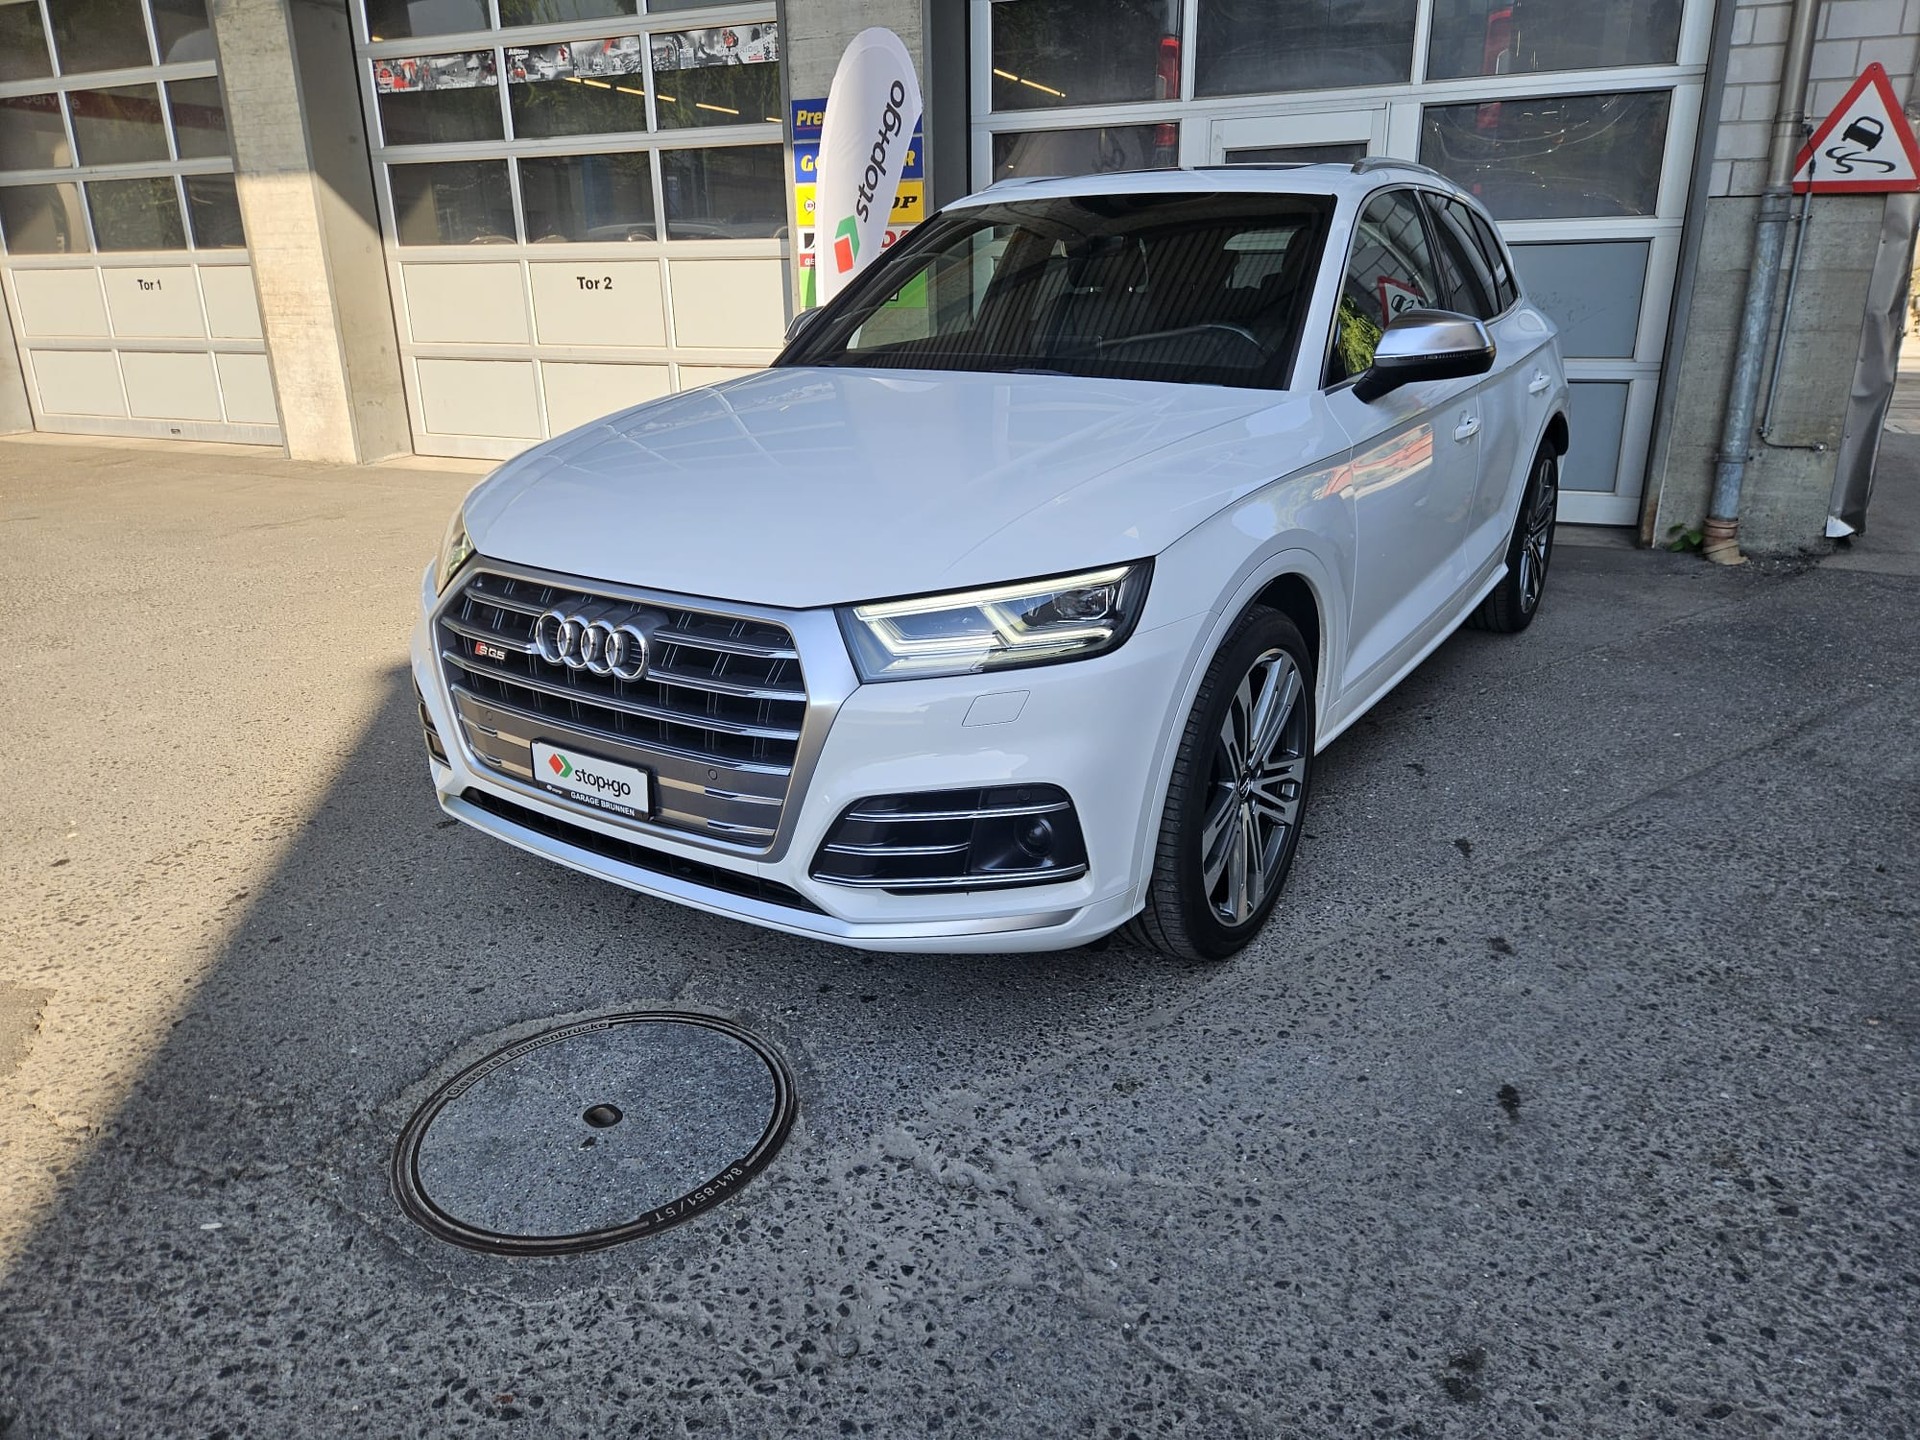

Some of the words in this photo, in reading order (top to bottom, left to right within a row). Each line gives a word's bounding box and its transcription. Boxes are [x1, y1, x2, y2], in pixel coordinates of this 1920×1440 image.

[796, 110, 825, 127] Pre
[856, 80, 905, 223] stop+go
[137, 279, 154, 290] Tor
[157, 279, 162, 290] 1
[577, 276, 600, 290] Tor
[603, 276, 613, 290] 2
[575, 768, 631, 797] stop+go
[570, 791, 600, 807] GARAGE
[600, 799, 635, 817] BRUNNEN
[447, 1056, 505, 1096] Giesserei
[506, 1021, 608, 1058] Emmenbrücke
